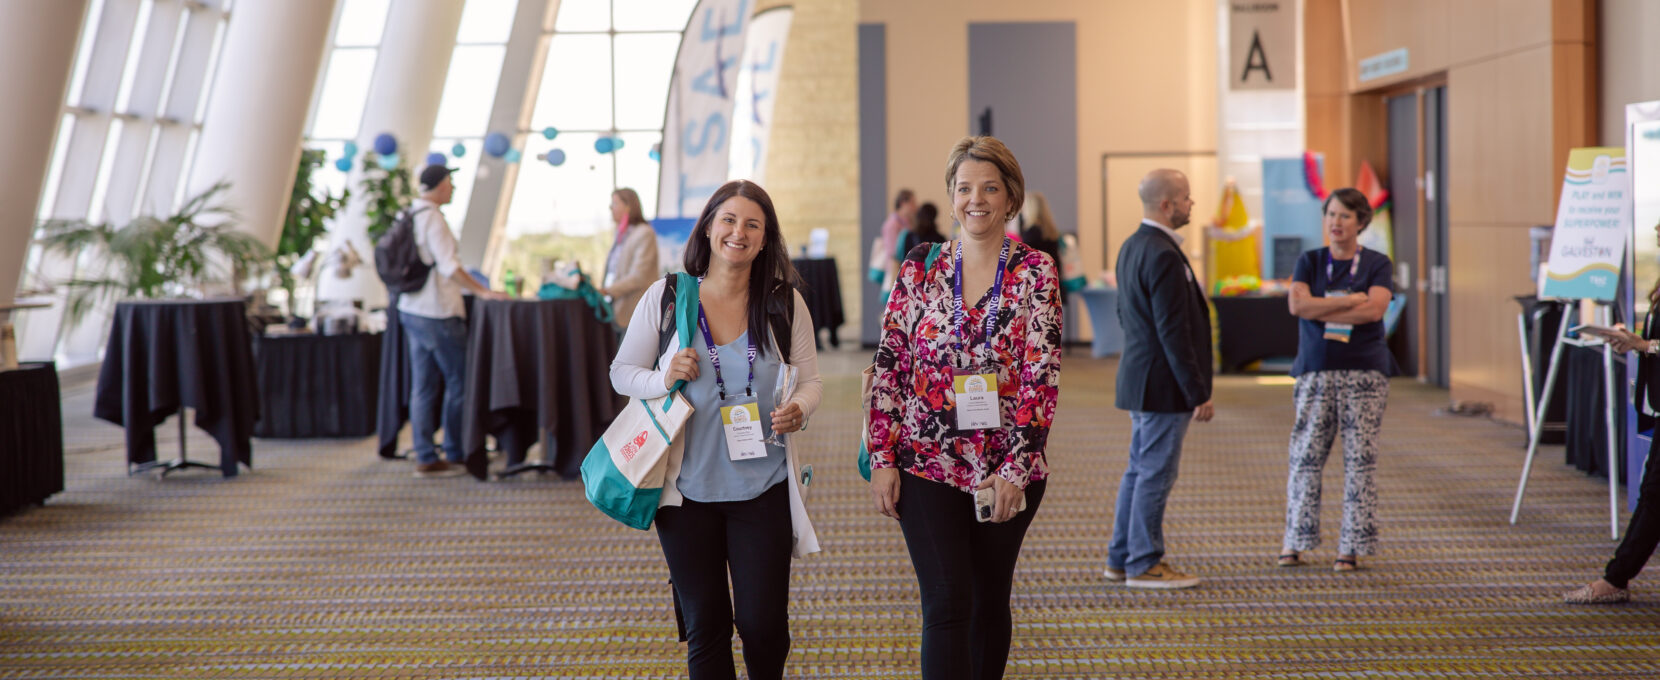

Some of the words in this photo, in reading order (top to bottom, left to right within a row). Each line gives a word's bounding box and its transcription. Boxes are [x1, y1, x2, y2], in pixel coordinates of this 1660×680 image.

[1241, 29, 1272, 82] A
[954, 297, 962, 331] IRVING
[986, 296, 999, 331] IRVING
